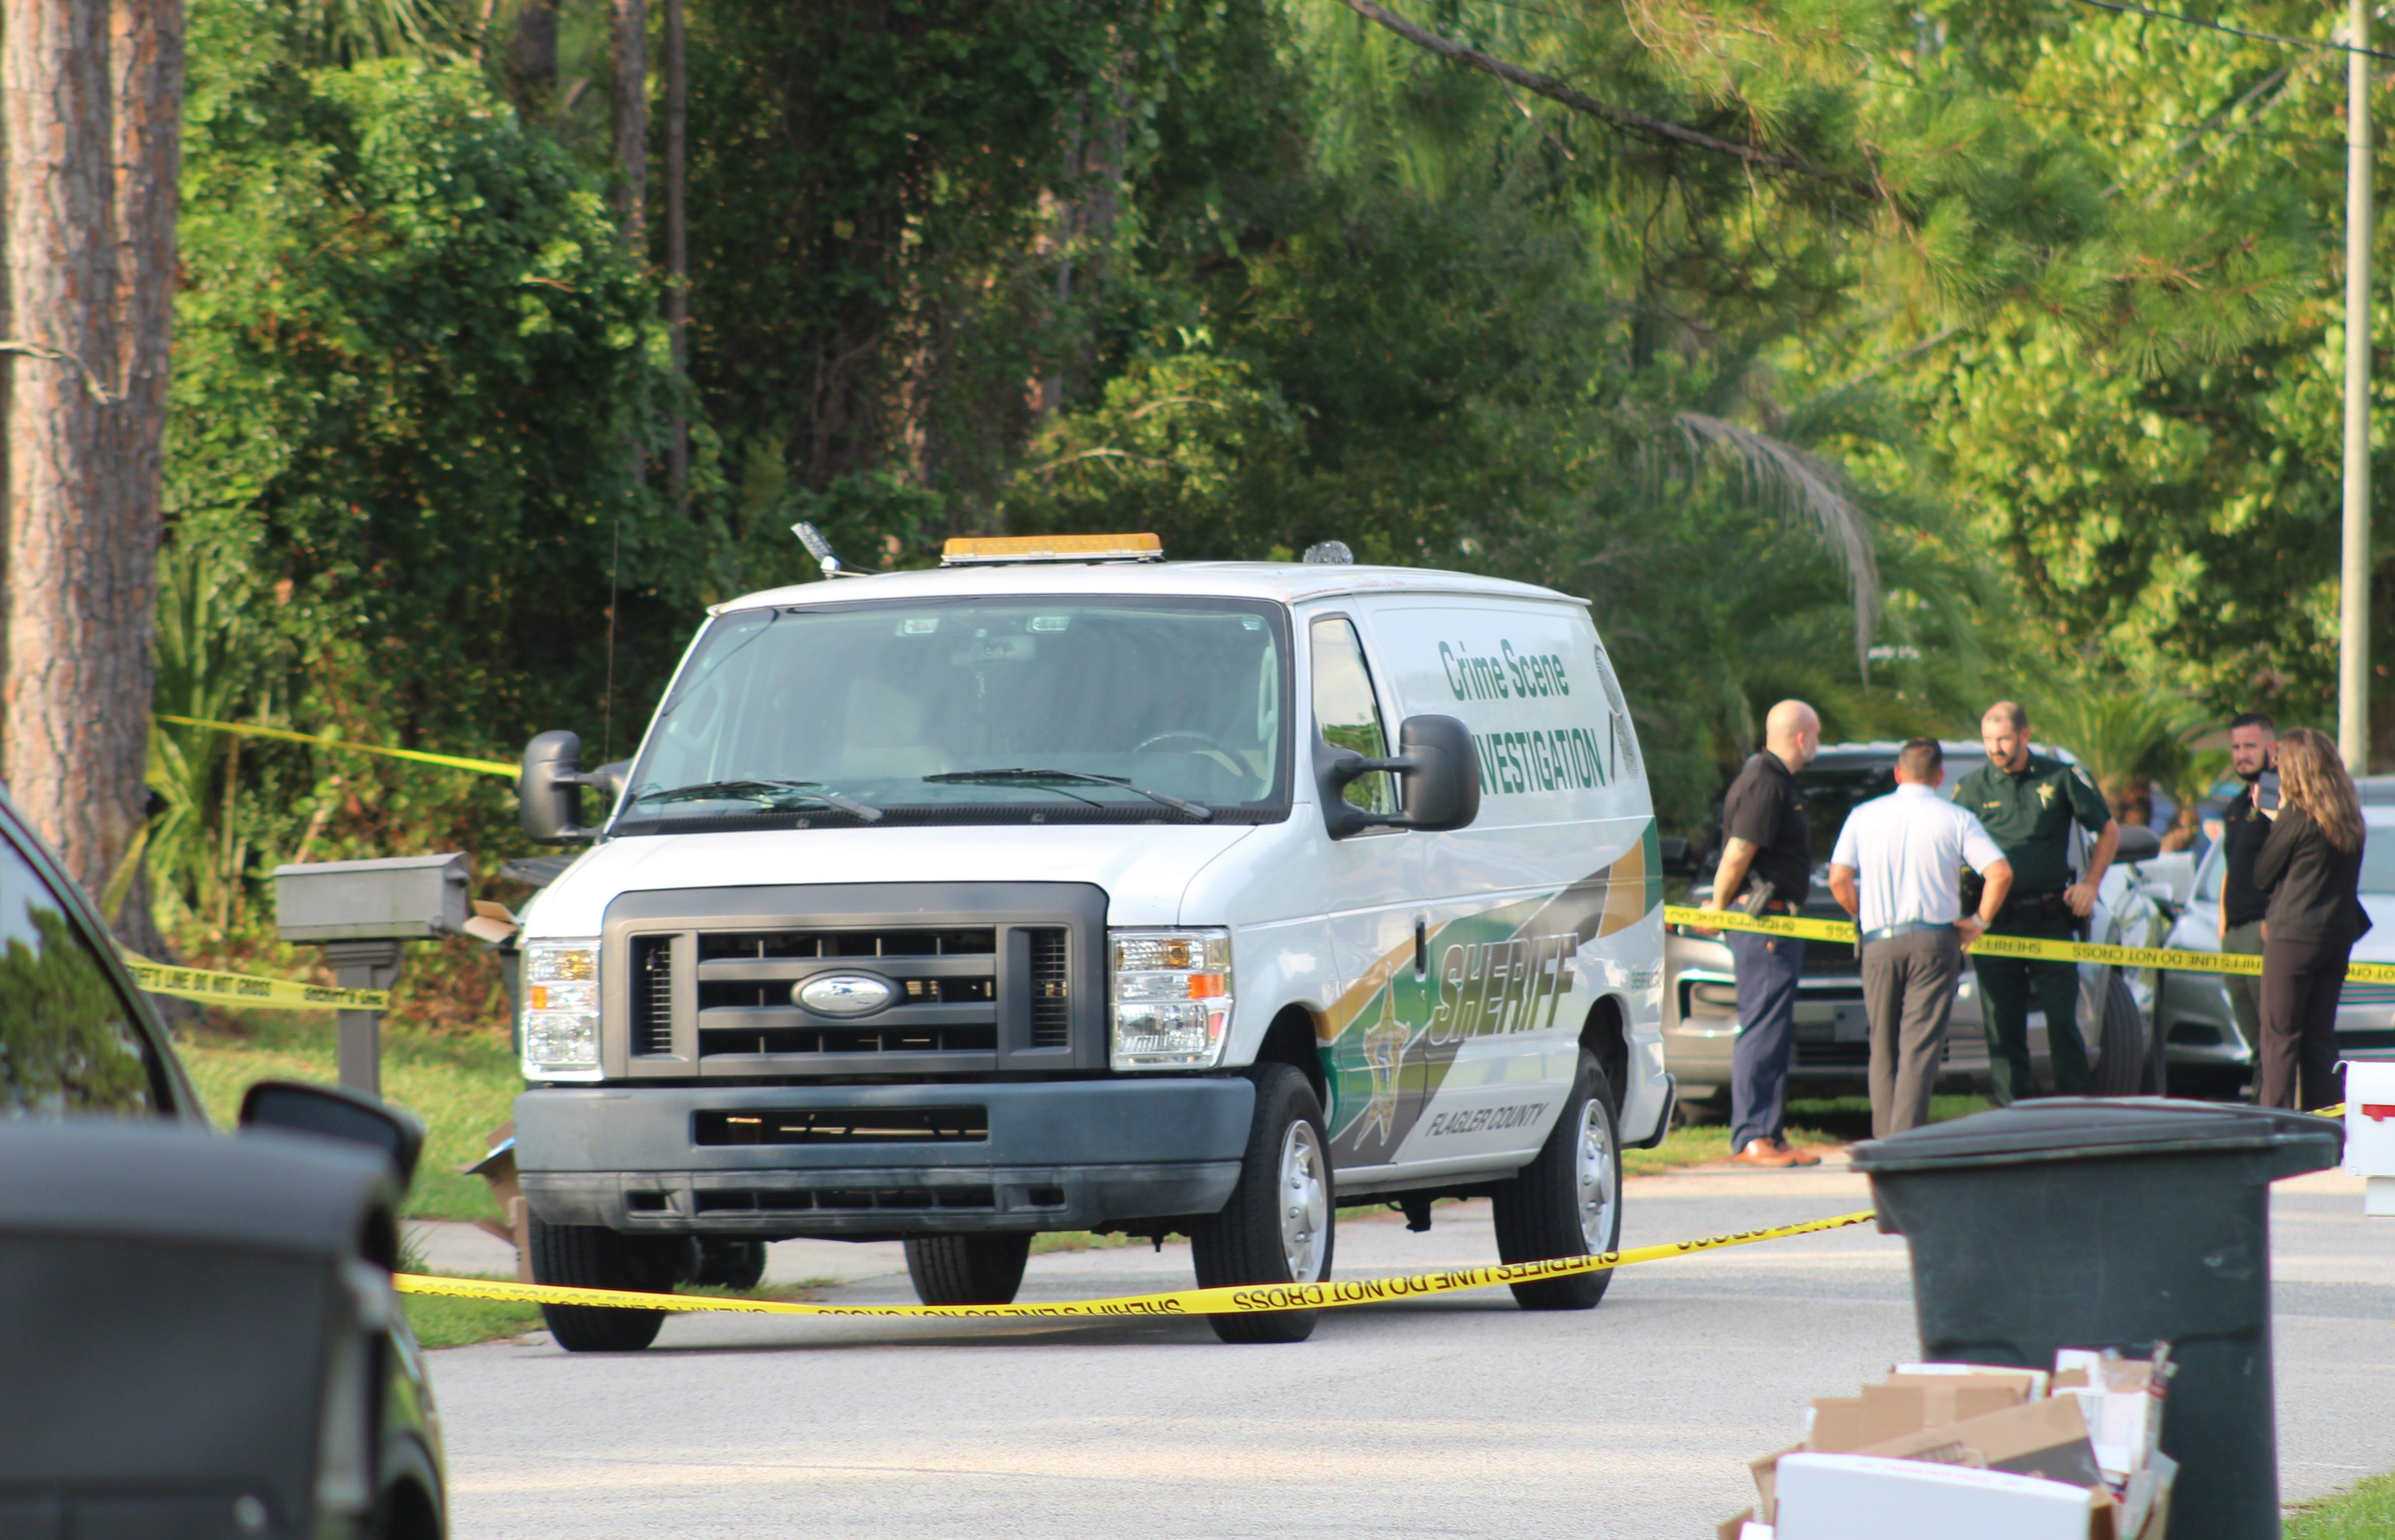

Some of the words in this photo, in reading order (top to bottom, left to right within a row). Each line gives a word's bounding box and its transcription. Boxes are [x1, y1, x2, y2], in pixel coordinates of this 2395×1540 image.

[1438, 640, 1509, 701] Crime
[1500, 638, 1569, 698] Scene
[1470, 728, 1606, 796] NVESTIGATION
[1825, 924, 1855, 939] OSS
[2072, 945, 2123, 961] CROSS
[2127, 950, 2158, 963] NOT
[2161, 953, 2182, 965] DO
[2186, 955, 2218, 967] LINE
[2221, 957, 2261, 969] RIFFS
[2375, 968, 2395, 980] OT
[1430, 932, 1579, 1046] SHERIFF
[1425, 1108, 1493, 1136] FLAGLER
[1487, 1102, 1549, 1130] COUNTY
[1330, 1279, 1384, 1302] NOT
[1389, 1274, 1428, 1295] DO
[1233, 1284, 1324, 1310] CROSS
